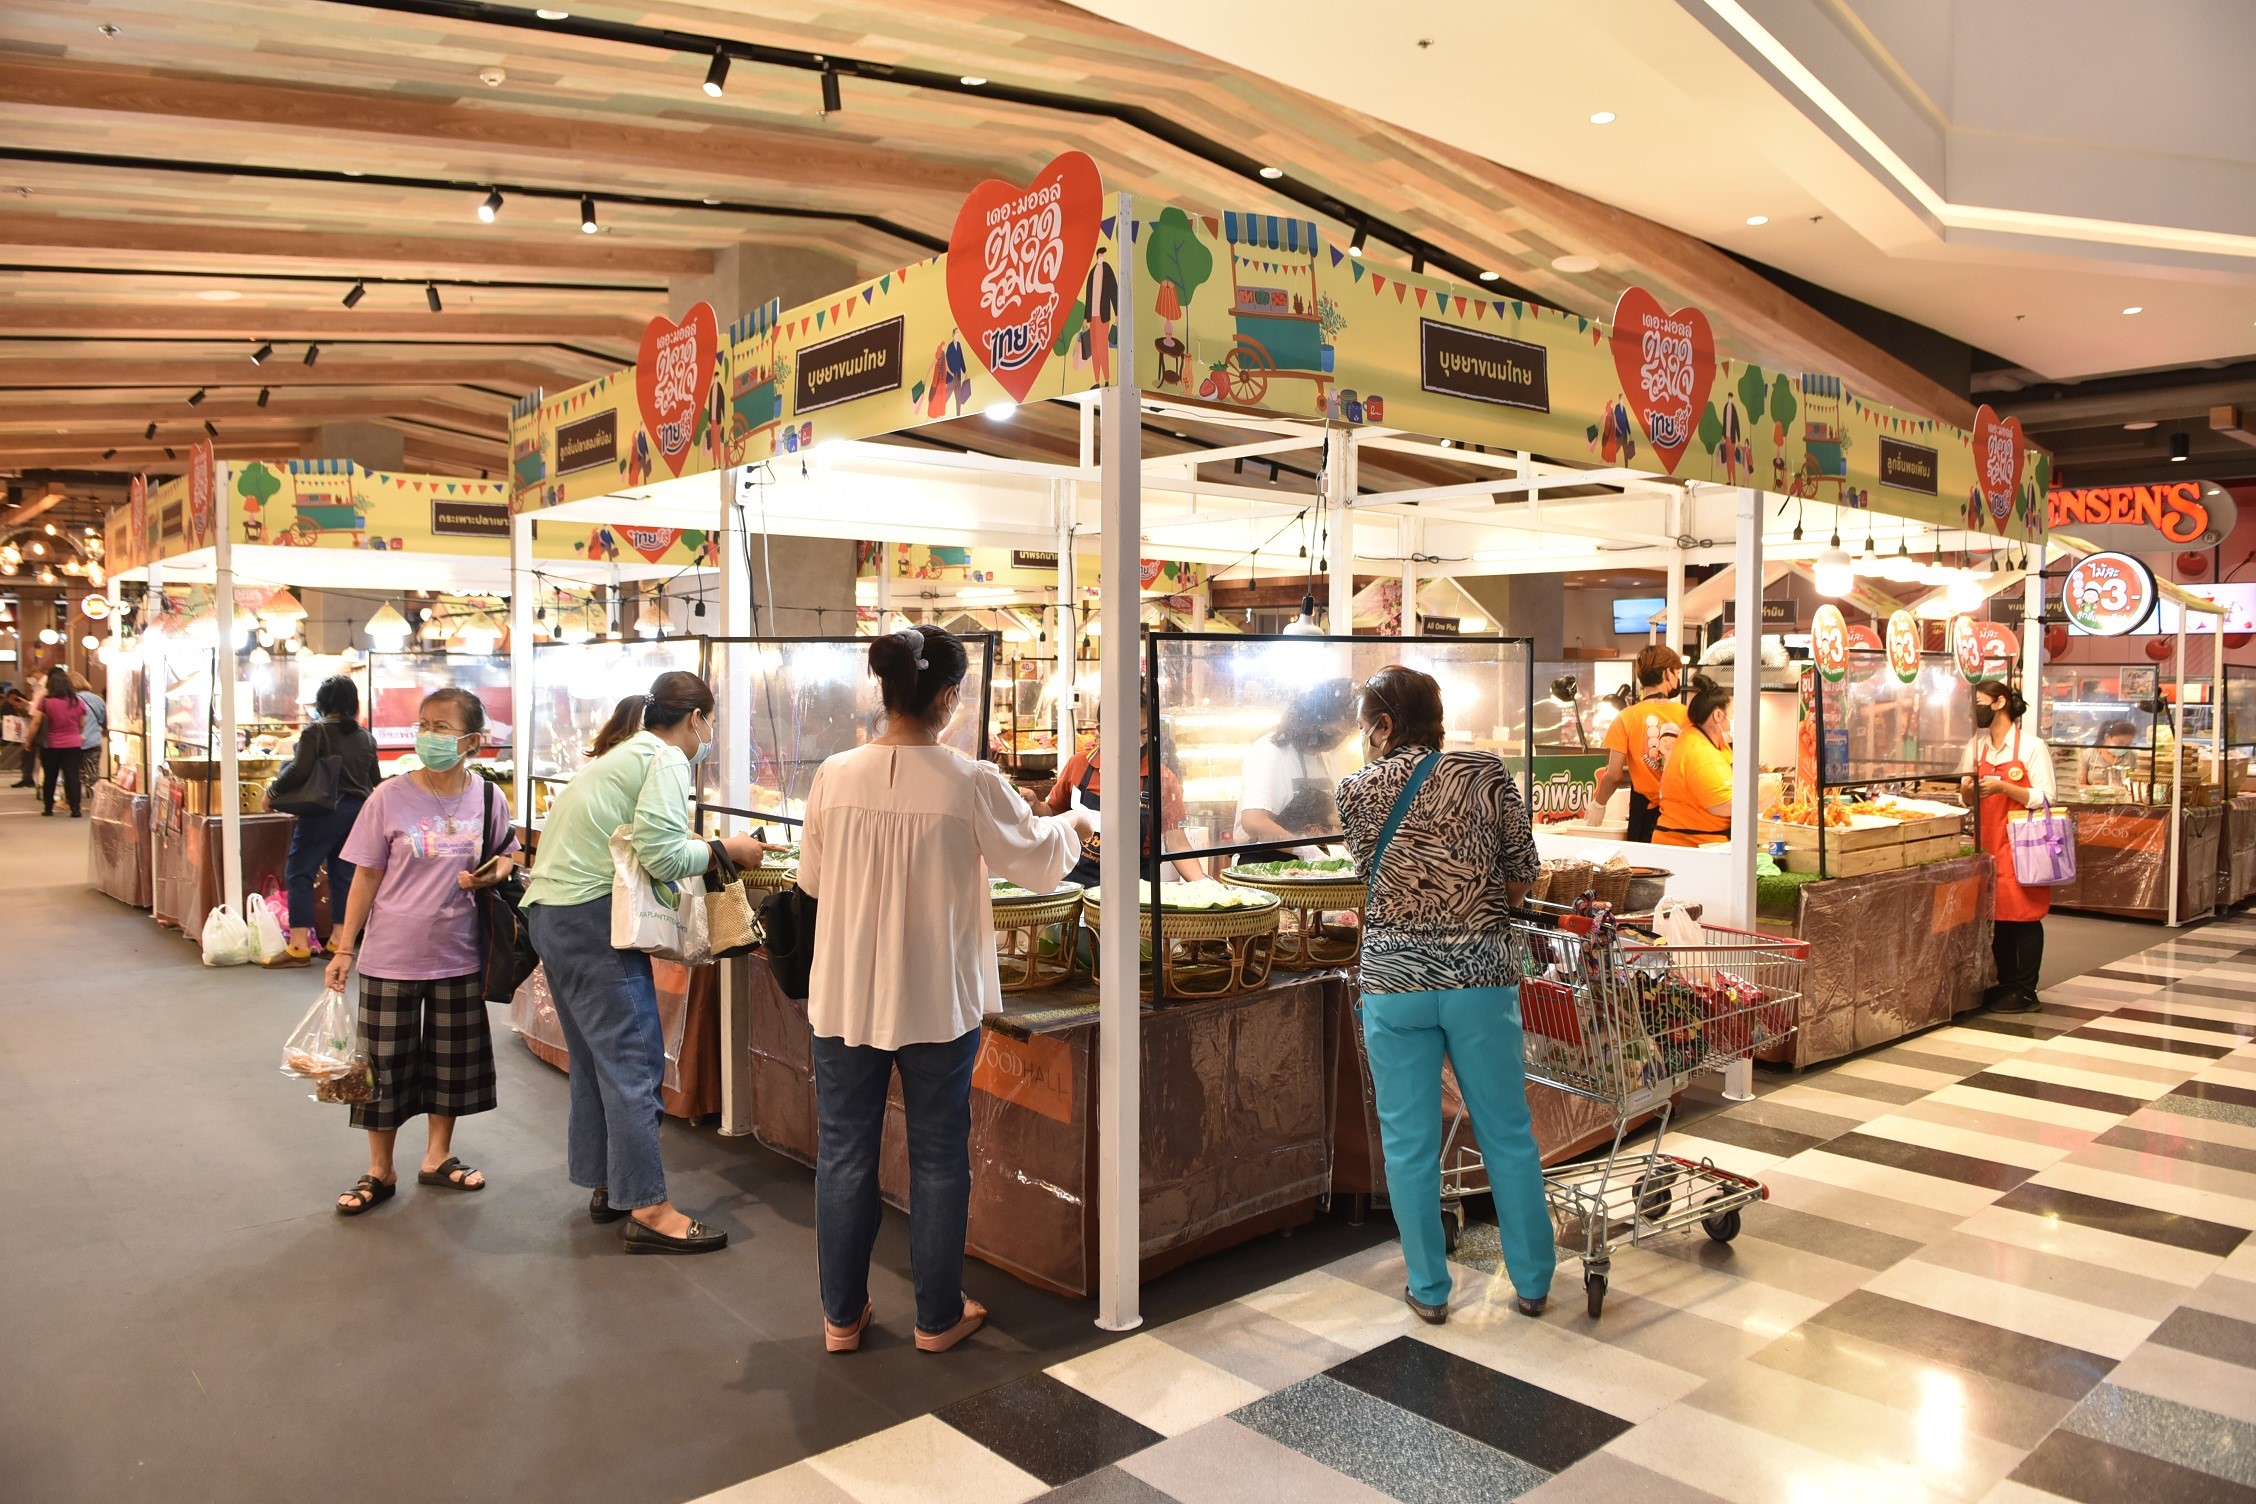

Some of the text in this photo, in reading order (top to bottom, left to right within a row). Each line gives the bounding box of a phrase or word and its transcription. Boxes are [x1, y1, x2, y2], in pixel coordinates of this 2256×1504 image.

[985, 202, 1062, 270] ตลาด
[808, 348, 887, 394] บุษยาขนมไทย
[1439, 350, 1532, 386] บุษยาขนมไทย
[2088, 562, 2120, 578] ไม้ละ
[1427, 622, 1435, 630] All
[1435, 622, 1446, 631] One
[1532, 772, 1594, 812] อเพียง
